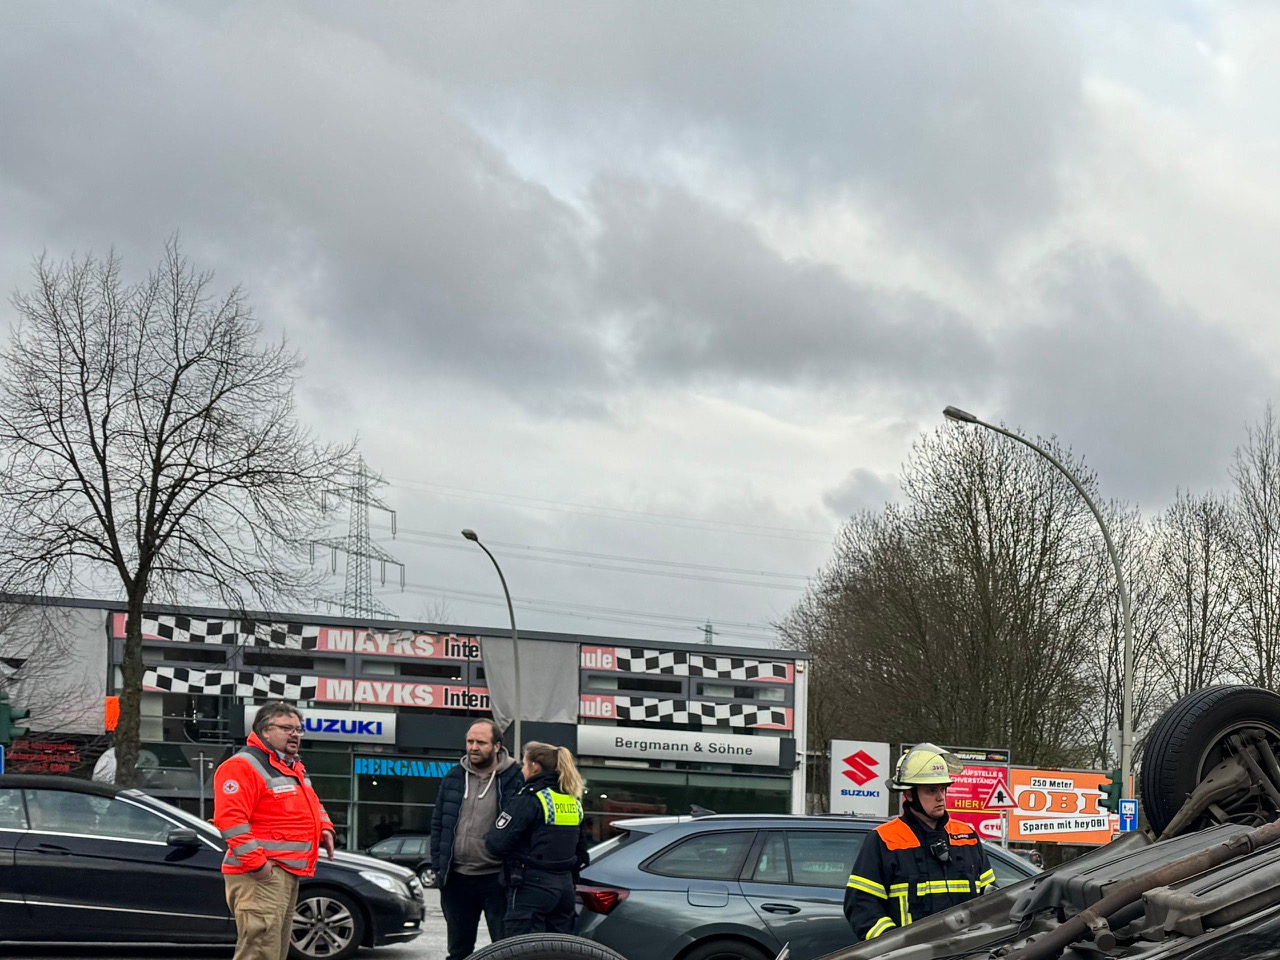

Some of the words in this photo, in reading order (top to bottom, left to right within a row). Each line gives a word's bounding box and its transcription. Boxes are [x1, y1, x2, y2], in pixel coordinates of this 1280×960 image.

[327, 630, 434, 656] MAYKS
[326, 679, 433, 706] MAYKS
[615, 737, 689, 752] Bergmann
[693, 742, 703, 753] &
[708, 743, 752, 755] Söhne
[355, 758, 458, 778] BERGMAN
[1032, 779, 1046, 787] 250
[1049, 780, 1072, 788] Meter
[841, 789, 879, 797] SUZUKI
[1018, 790, 1101, 814] OBI
[955, 800, 978, 808] HIER
[1023, 822, 1054, 832] Sparen
[1057, 821, 1071, 829] mit
[1074, 819, 1105, 831] heyOBI
